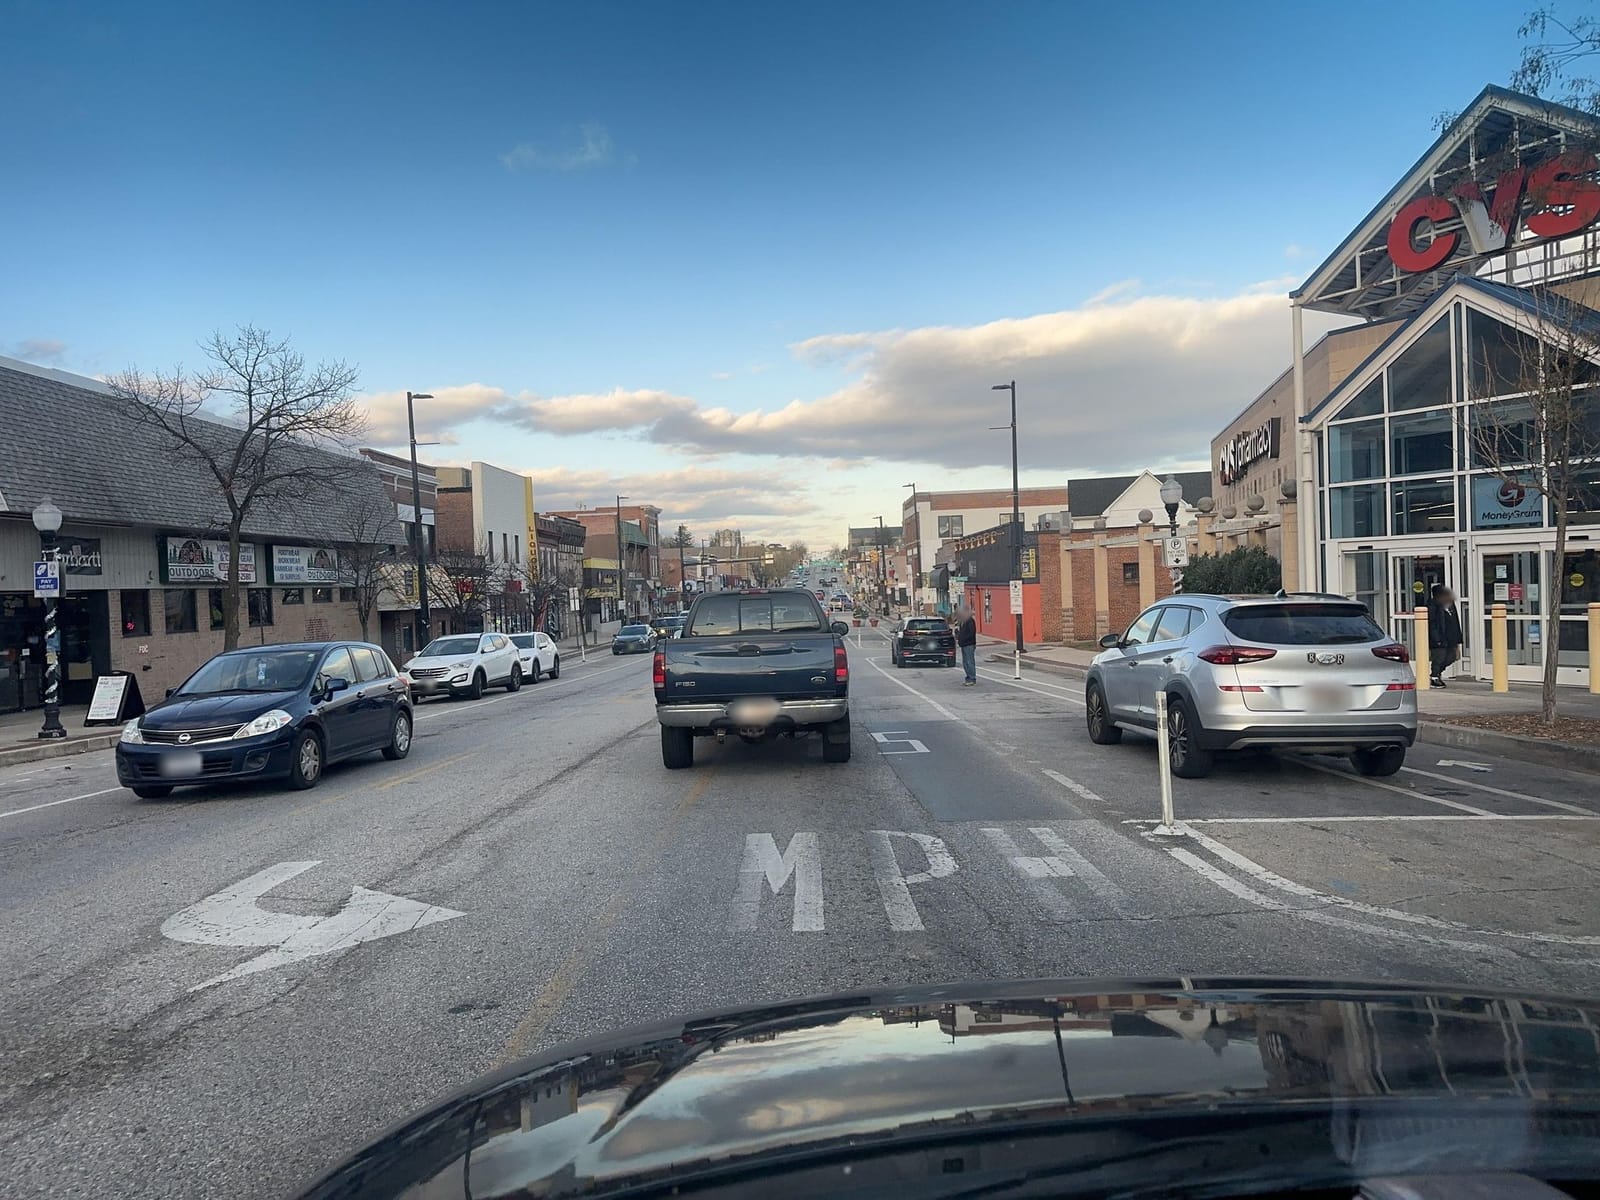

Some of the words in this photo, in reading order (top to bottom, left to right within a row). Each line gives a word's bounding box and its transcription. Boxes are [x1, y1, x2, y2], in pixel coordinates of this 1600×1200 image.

[1387, 151, 1600, 272] CVS
[1220, 440, 1235, 481] CVS
[1237, 420, 1271, 472] pharmacy
[1482, 509, 1541, 521] MoneyGram
[169, 567, 214, 577] OUTDOORS
[307, 571, 337, 579] OUTDOORS
